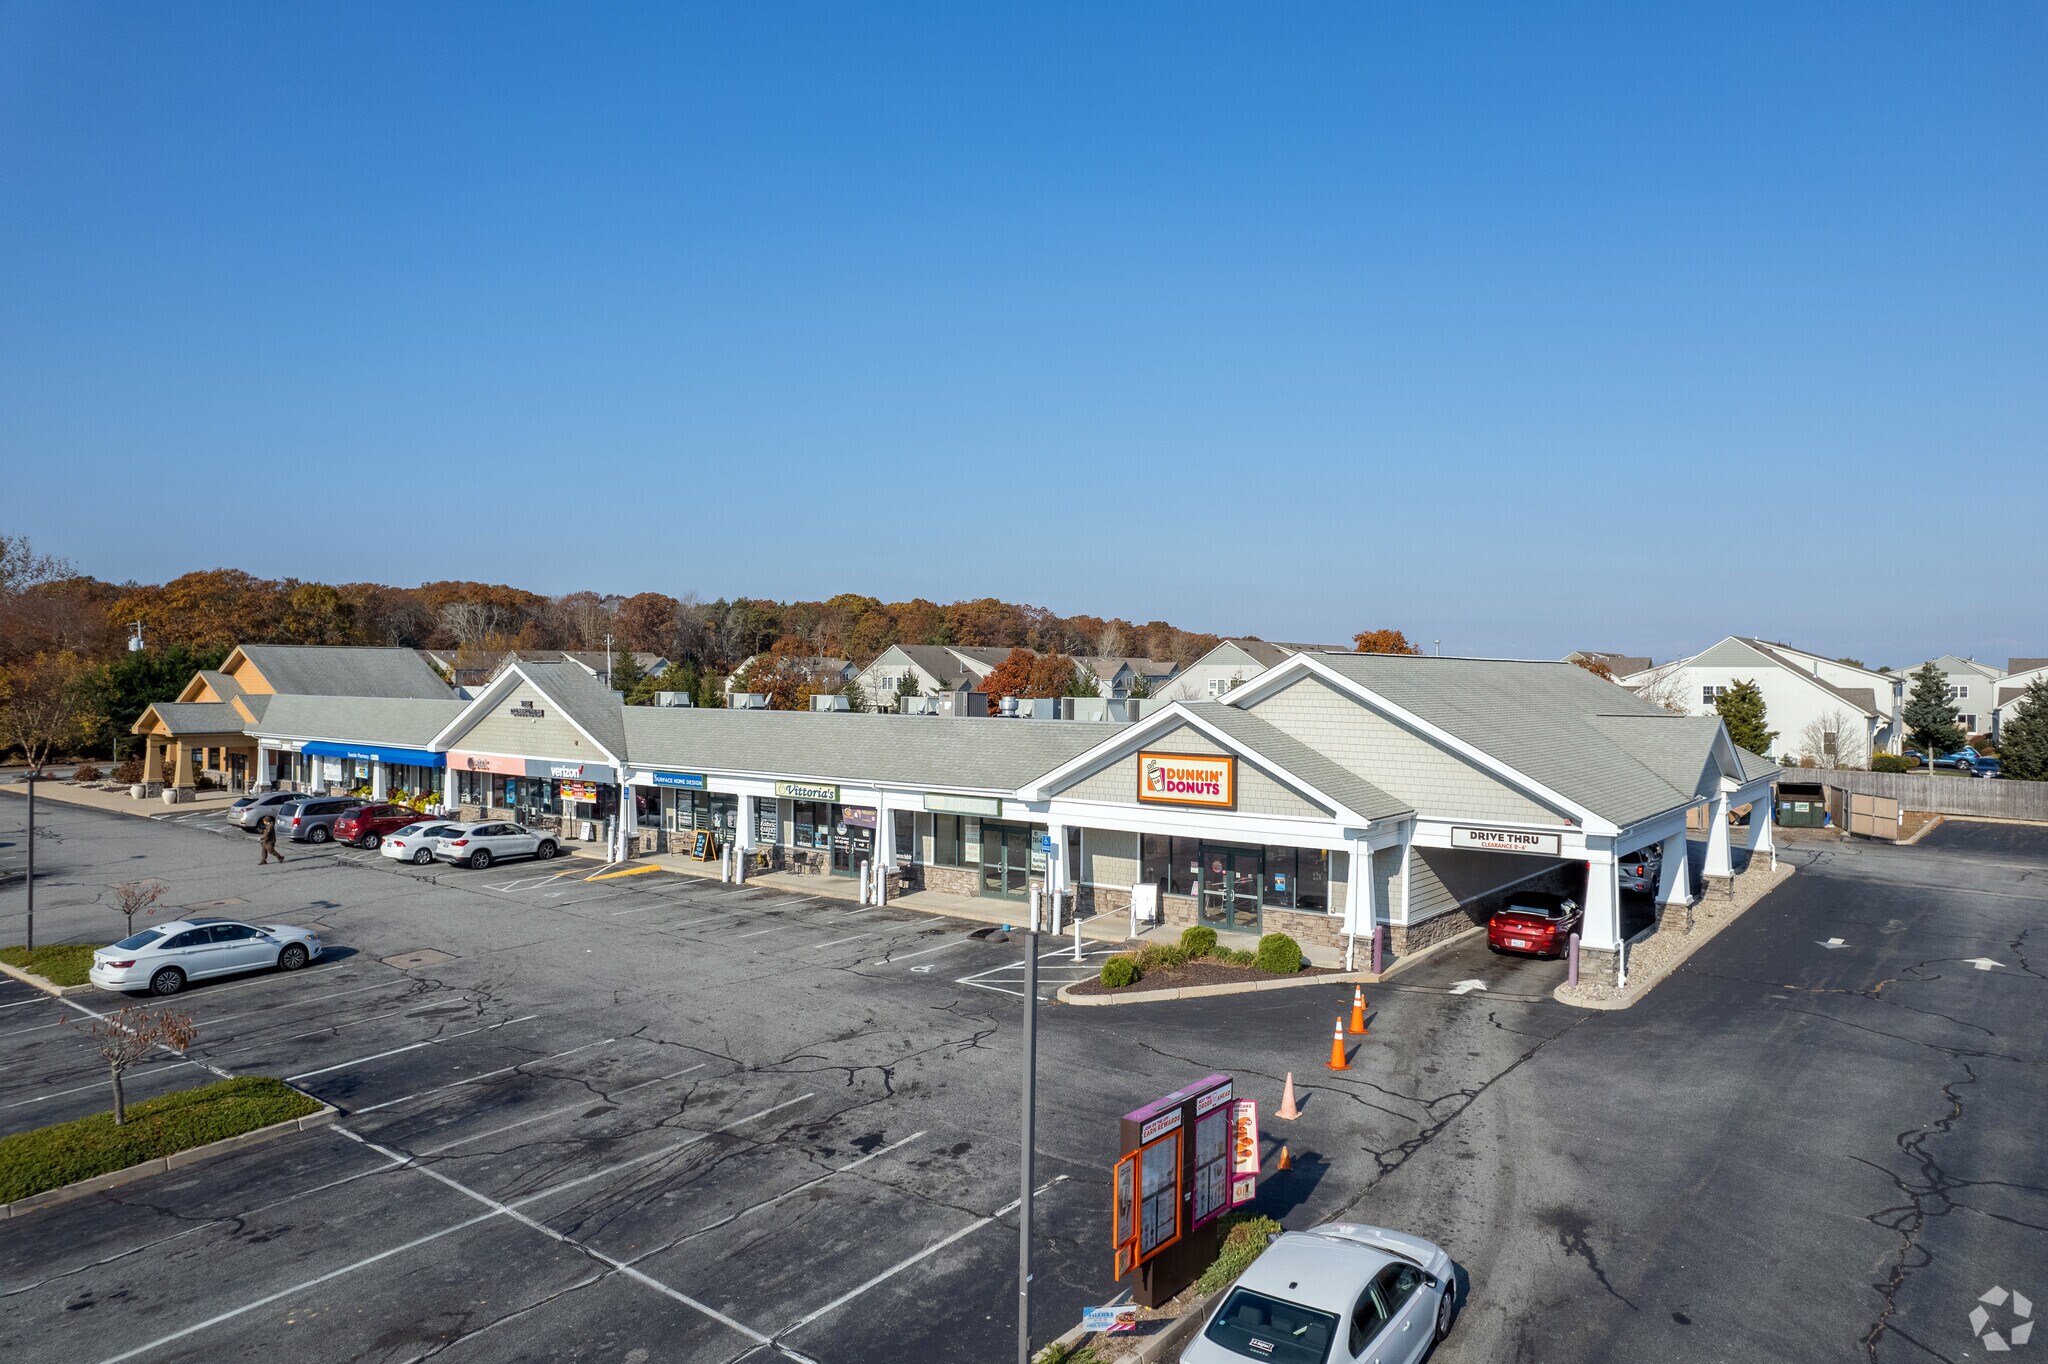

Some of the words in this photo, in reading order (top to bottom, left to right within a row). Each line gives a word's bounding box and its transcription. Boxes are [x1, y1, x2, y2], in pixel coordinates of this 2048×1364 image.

[551, 765, 580, 778] verizon
[1167, 768, 1223, 782] DUNKIN'
[786, 784, 834, 799] Vittoria's
[1167, 780, 1220, 795] DONUTS
[1470, 831, 1504, 841] DRIVE
[1507, 834, 1539, 844] THRU
[1481, 841, 1512, 849] CLEARANCE
[1198, 1099, 1212, 1110] ORDER
[1217, 1090, 1231, 1101] AHEAD
[1144, 1128, 1156, 1138] EARN
[1158, 1114, 1180, 1131] REWARDS
